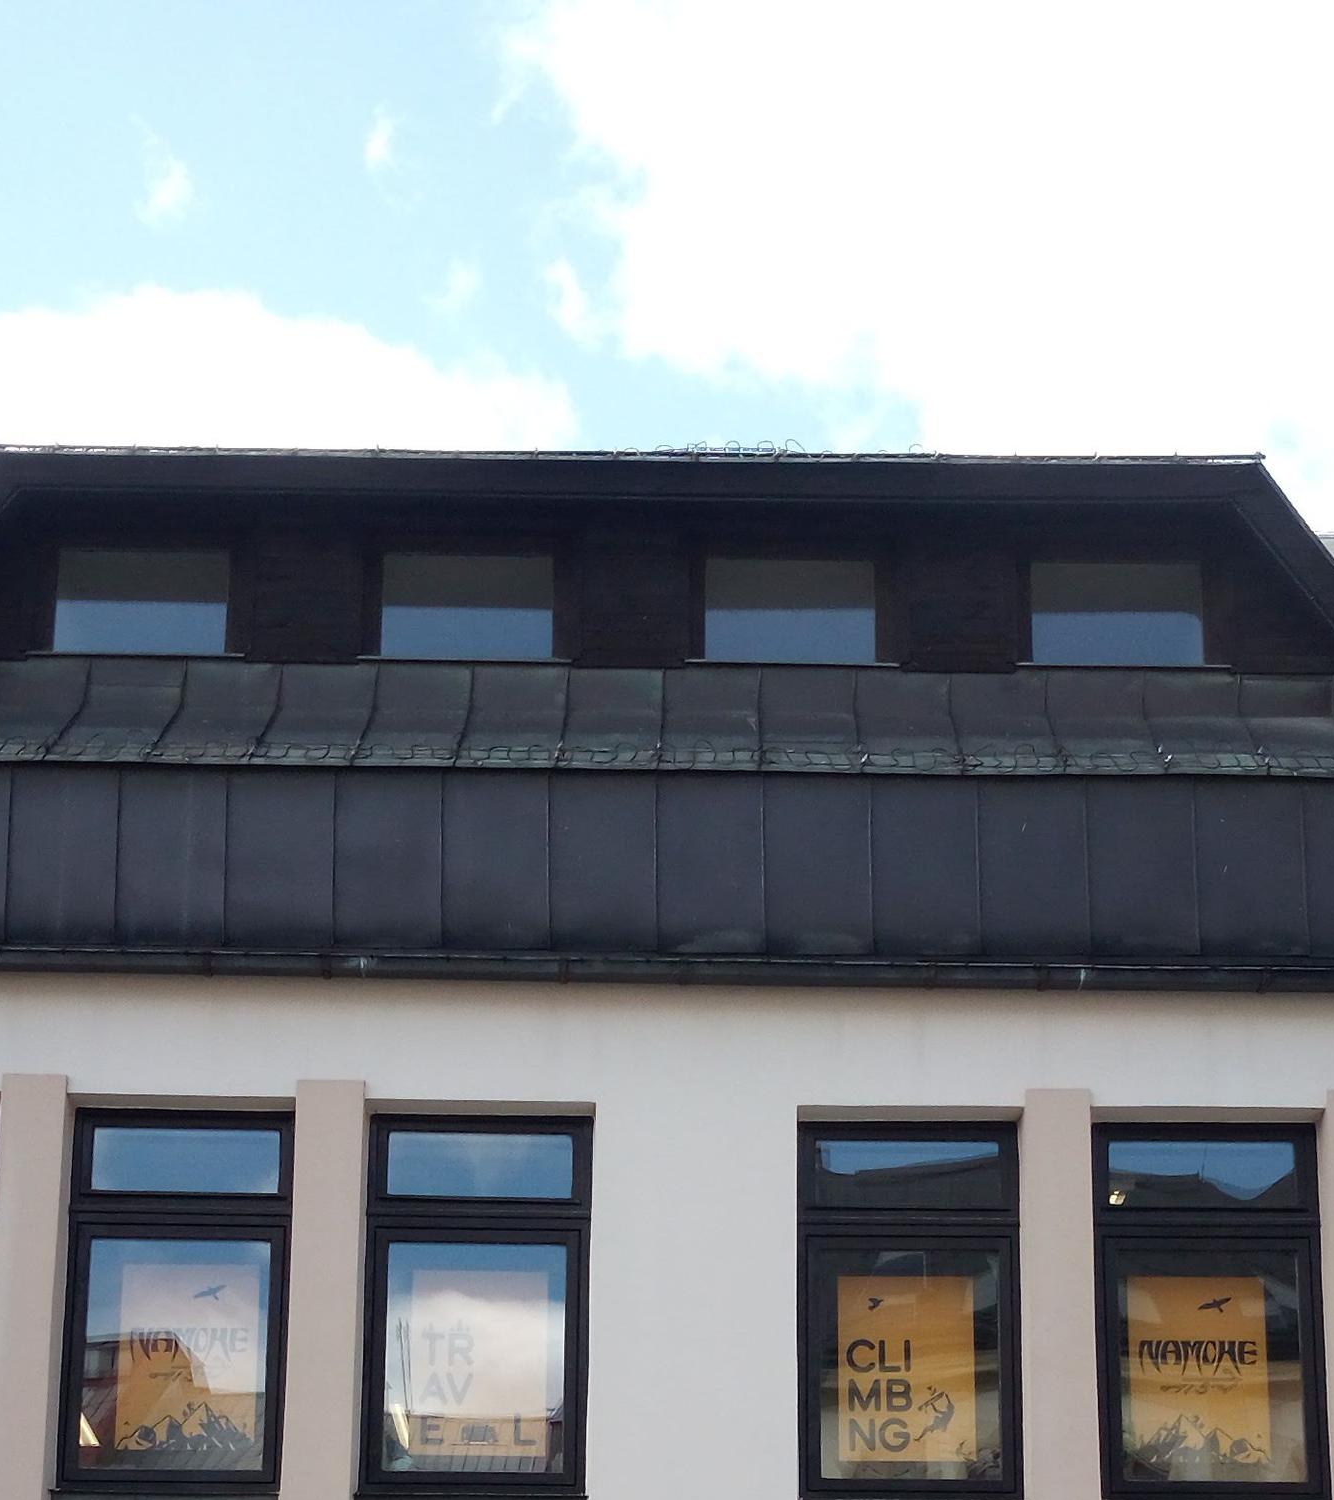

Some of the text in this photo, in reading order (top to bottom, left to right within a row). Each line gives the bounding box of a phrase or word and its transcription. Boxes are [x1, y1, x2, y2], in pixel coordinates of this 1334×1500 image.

[846, 1338, 911, 1373] CLI
[848, 1378, 913, 1412] MB
[848, 1416, 911, 1453] NG
